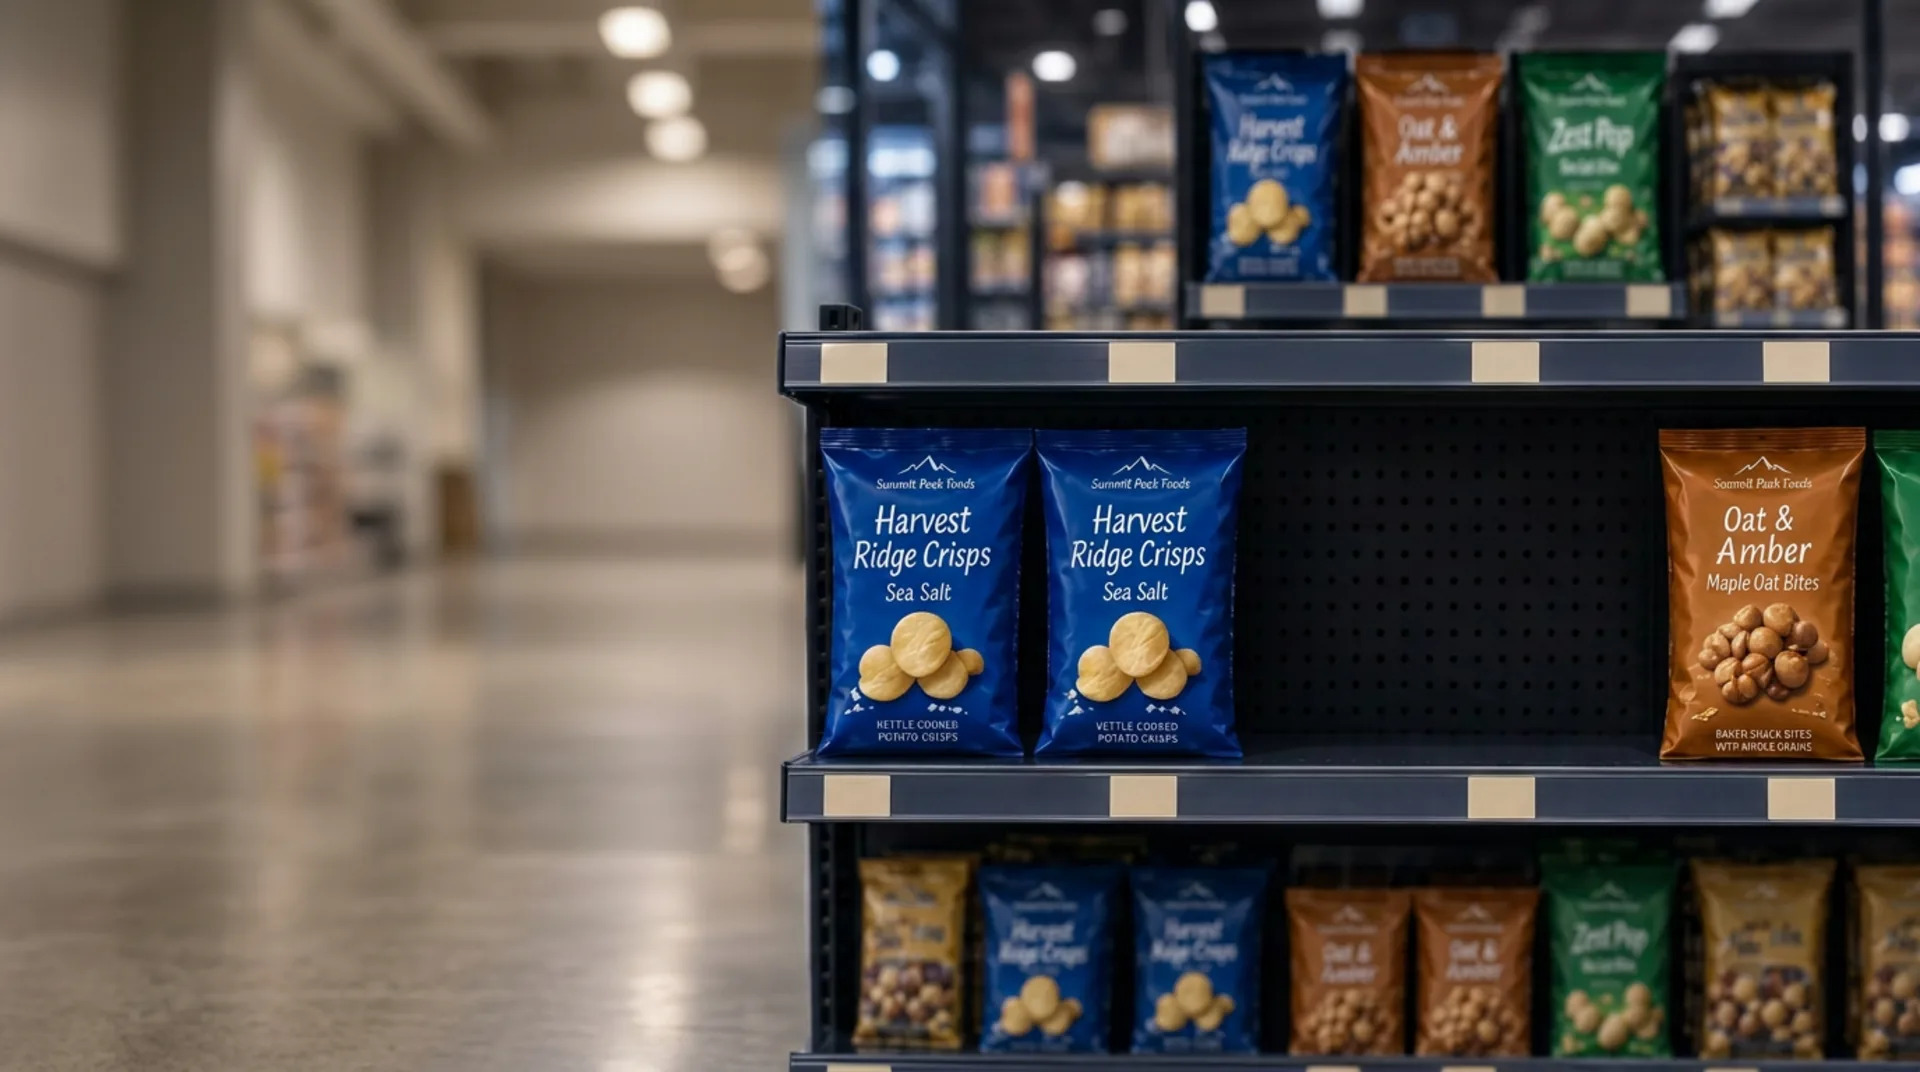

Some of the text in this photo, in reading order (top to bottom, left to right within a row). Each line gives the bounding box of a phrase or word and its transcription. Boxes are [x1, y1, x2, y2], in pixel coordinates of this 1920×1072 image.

[875, 504, 972, 535] Harvest
[1092, 504, 1188, 535] Harvest
[1724, 504, 1793, 532] Oat &
[853, 540, 991, 577] Ridge Crisps
[1071, 539, 1206, 576] Ridge Crisps
[1716, 534, 1812, 564] Amber
[885, 582, 952, 602] Sea Salt
[1103, 581, 1169, 601] Sea Salt
[1706, 573, 1819, 595] Maple Oat Bites
